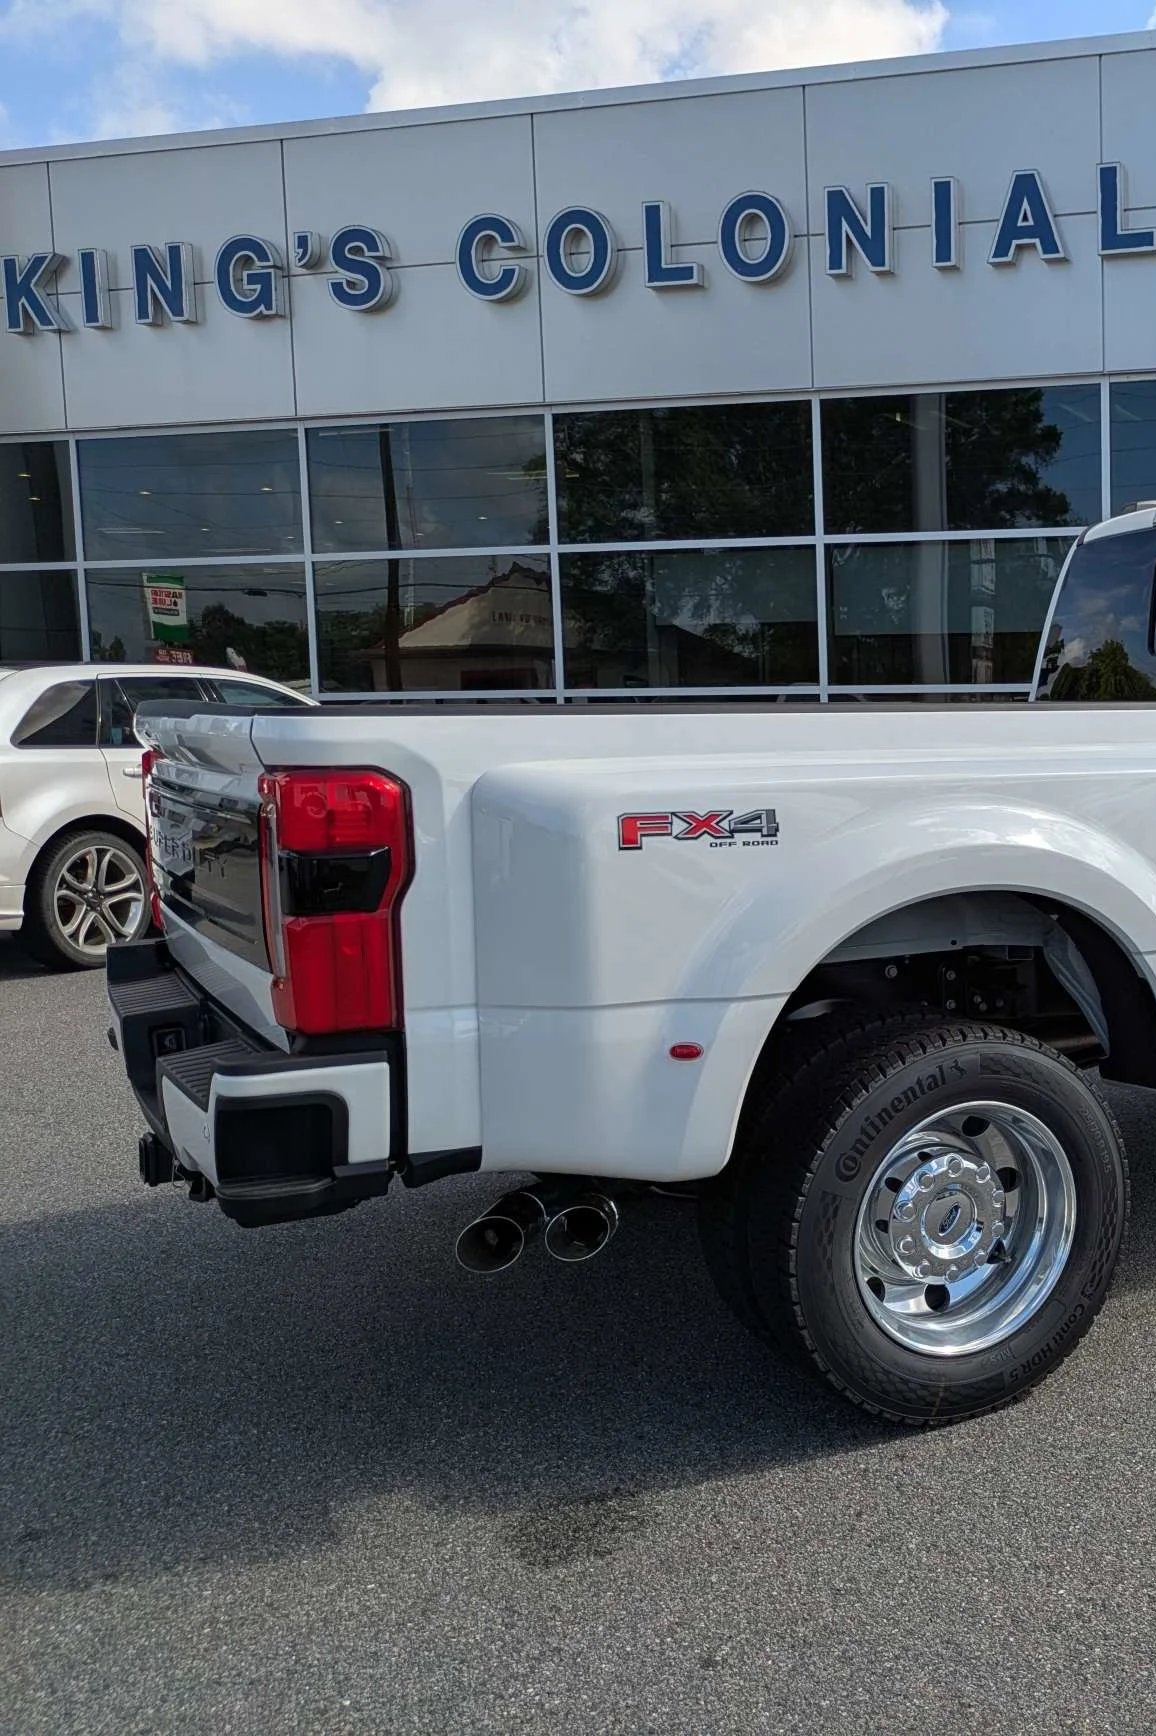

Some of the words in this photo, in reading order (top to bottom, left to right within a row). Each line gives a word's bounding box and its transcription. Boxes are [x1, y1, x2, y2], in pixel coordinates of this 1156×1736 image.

[1, 225, 395, 335] KING'S
[617, 808, 779, 850] FX4
[742, 839, 779, 847] ROAD
[181, 841, 229, 879] DTY
[834, 1064, 947, 1183] Continental
[1052, 1303, 1086, 1347] Conti
[1019, 1342, 1053, 1378] HDR
